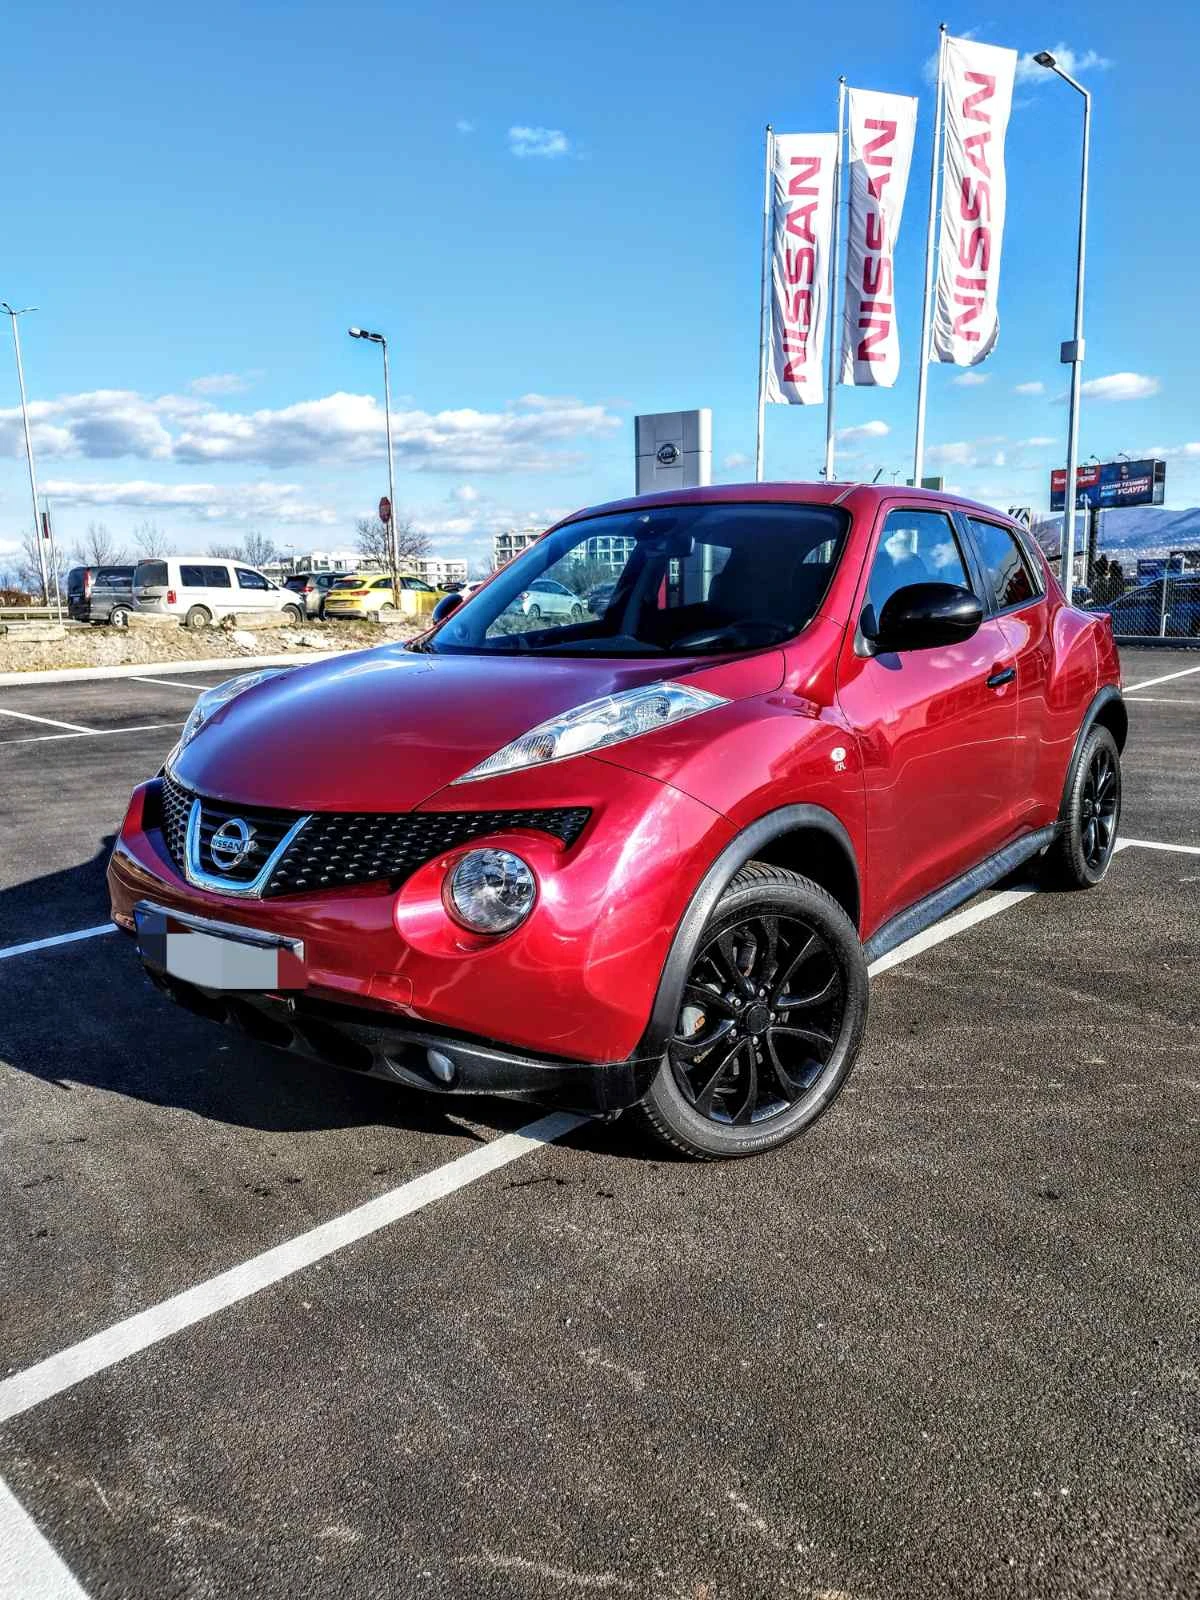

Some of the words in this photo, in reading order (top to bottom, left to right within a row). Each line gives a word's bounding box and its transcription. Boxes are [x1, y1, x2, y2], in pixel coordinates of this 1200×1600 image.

[783, 156, 821, 383] NISSAN
[952, 71, 996, 342] NISSAN
[212, 838, 240, 850] NISSAN
